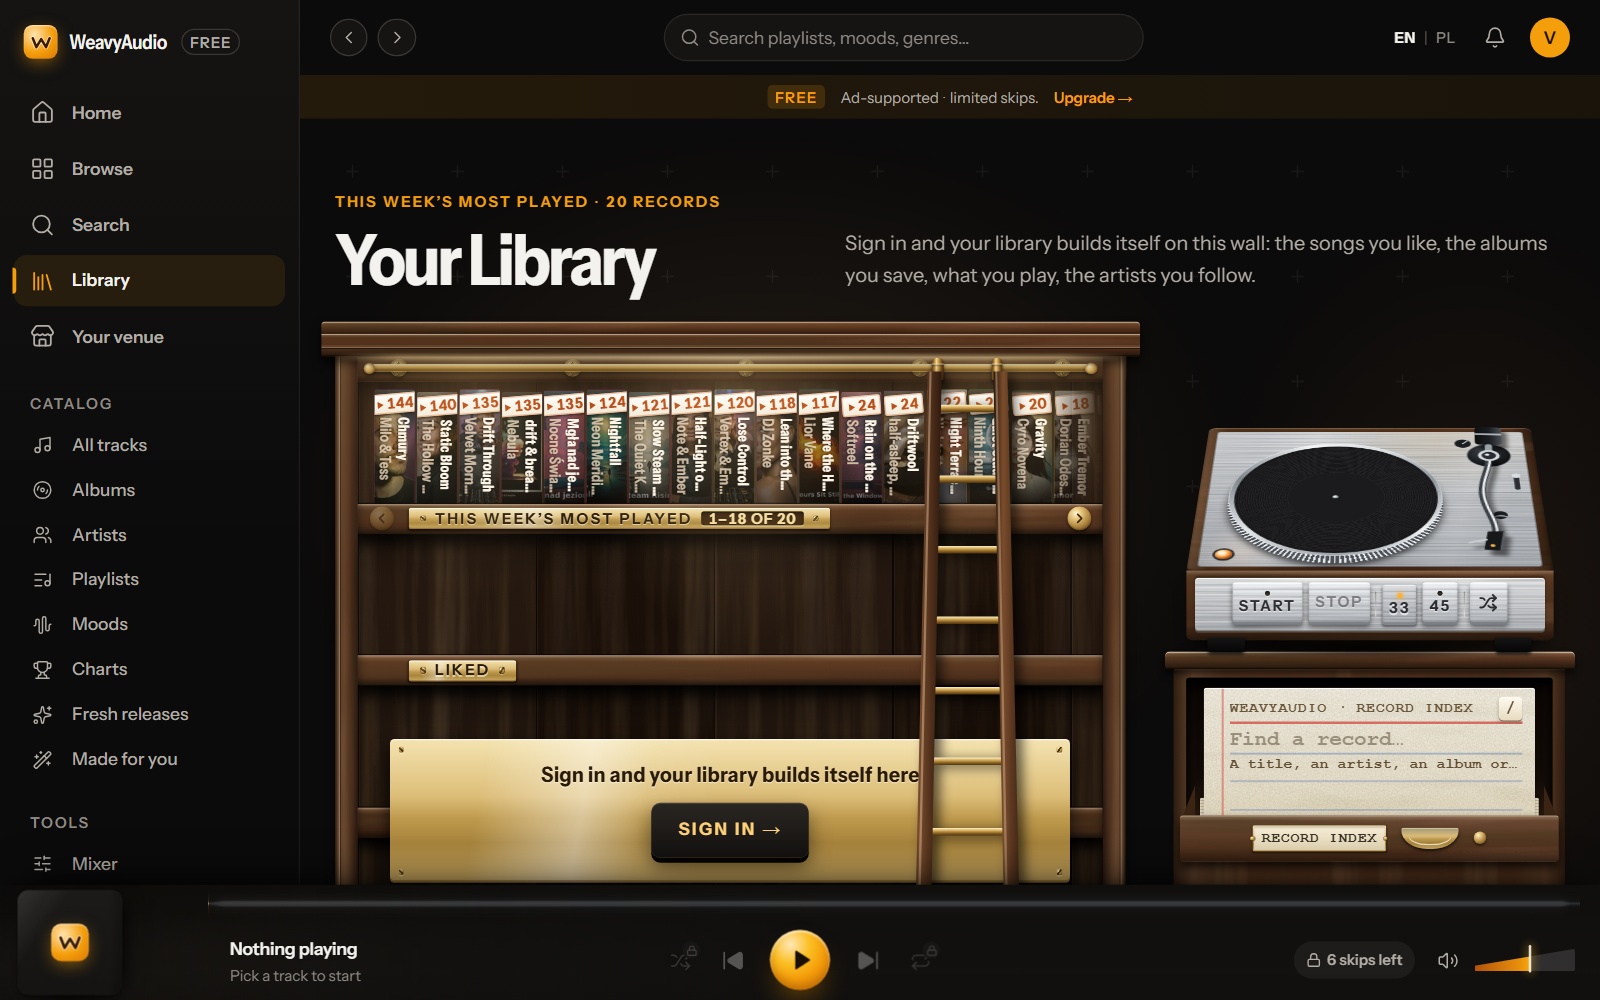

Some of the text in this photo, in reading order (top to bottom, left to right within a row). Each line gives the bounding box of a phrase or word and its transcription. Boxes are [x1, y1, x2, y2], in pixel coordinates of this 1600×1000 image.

[69, 34, 167, 53] WeavyAudio
[191, 37, 230, 48] FREE
[709, 31, 968, 48] Search playlists, moods, genres...
[1395, 32, 1455, 44] EN PL
[1544, 31, 1556, 44] V
[776, 92, 816, 103] FREE
[841, 92, 1038, 106] Ad-supported limited skips.
[1055, 92, 1115, 106] Upgrade
[73, 106, 121, 119] Home
[73, 162, 133, 175] Browse
[335, 196, 719, 207] THIS WEEK’S MOST PLAYED 20 RECORDS
[72, 218, 129, 231] Search
[335, 233, 657, 300] Your Library
[73, 273, 130, 290] Library
[845, 267, 1255, 286] you save, what you play, the artists you follow.
[72, 330, 164, 343] Your venue
[30, 398, 111, 409] CATALOG
[388, 396, 414, 409] 144
[430, 399, 456, 411] 140
[472, 396, 499, 409] 135
[515, 399, 541, 411] 135
[557, 397, 583, 410] 135
[600, 396, 626, 409] 124
[642, 399, 668, 411] 121
[684, 396, 710, 409] 121
[728, 396, 753, 409] 120
[770, 397, 796, 410] 118
[812, 396, 837, 409] 117
[858, 399, 876, 411] 24
[900, 398, 918, 410] 24
[1029, 398, 1046, 410] 20
[1072, 398, 1089, 410] 18
[549, 419, 561, 454] Nocne
[565, 418, 579, 446] Mgła
[1033, 419, 1047, 458] Gravity
[72, 438, 147, 451] All tracks
[396, 417, 410, 461] Chmury
[507, 420, 519, 459] Nebula
[608, 418, 621, 466] Nightfall
[693, 418, 707, 469] Half-Light
[762, 419, 774, 468] DJ Zonke
[804, 418, 816, 469] Lior Vane
[847, 420, 859, 464] Softreel
[907, 419, 919, 471] Driftwool
[379, 418, 392, 480] Milo & Tess
[440, 420, 452, 490] Static Bloom
[480, 418, 495, 492] Drift Through
[737, 418, 750, 486] Lose Control
[1015, 419, 1030, 489] Cyro Novena
[464, 418, 477, 494] Velvet Morn...
[567, 449, 579, 471] nad
[677, 418, 689, 495] Note & Ember
[1077, 419, 1090, 496] Ember Tremor
[72, 483, 135, 496] Albums
[435, 513, 691, 525] THIS WEEK’S MOST PLAYED
[751, 513, 773, 525] OF
[777, 513, 797, 525] 20
[72, 528, 126, 541] Artists
[73, 572, 139, 589] Playlists
[1239, 600, 1294, 612] START
[1316, 596, 1361, 607] STOP
[1389, 602, 1408, 613] 33
[1430, 600, 1449, 611] 45
[73, 617, 128, 630] Moods
[72, 662, 127, 675] Charts
[435, 664, 490, 677] LIKED
[73, 707, 188, 720] Fresh releases
[1230, 704, 1473, 712] WEAVYAUDIO RECORD INDEX
[1231, 732, 1403, 745] Find a record...
[73, 752, 177, 769] Made for you
[1230, 760, 1239, 768] A
[1249, 759, 1298, 770] title,
[1338, 759, 1397, 770] artist,
[1437, 759, 1482, 768] album
[542, 766, 583, 787] Sign
[589, 766, 604, 782] in
[610, 767, 644, 782] and
[650, 771, 692, 786] your
[698, 766, 758, 786] library
[763, 766, 819, 782] builds
[825, 766, 872, 782] itself
[30, 817, 88, 828] TOOLS
[679, 822, 754, 836] SIGN IN
[1262, 834, 1377, 842] RECORD INDEX
[73, 857, 118, 870] Mixer
[230, 942, 357, 959] Nothing playing
[1327, 954, 1403, 968] 6 skips left
[231, 970, 361, 981] Pick a track to start
